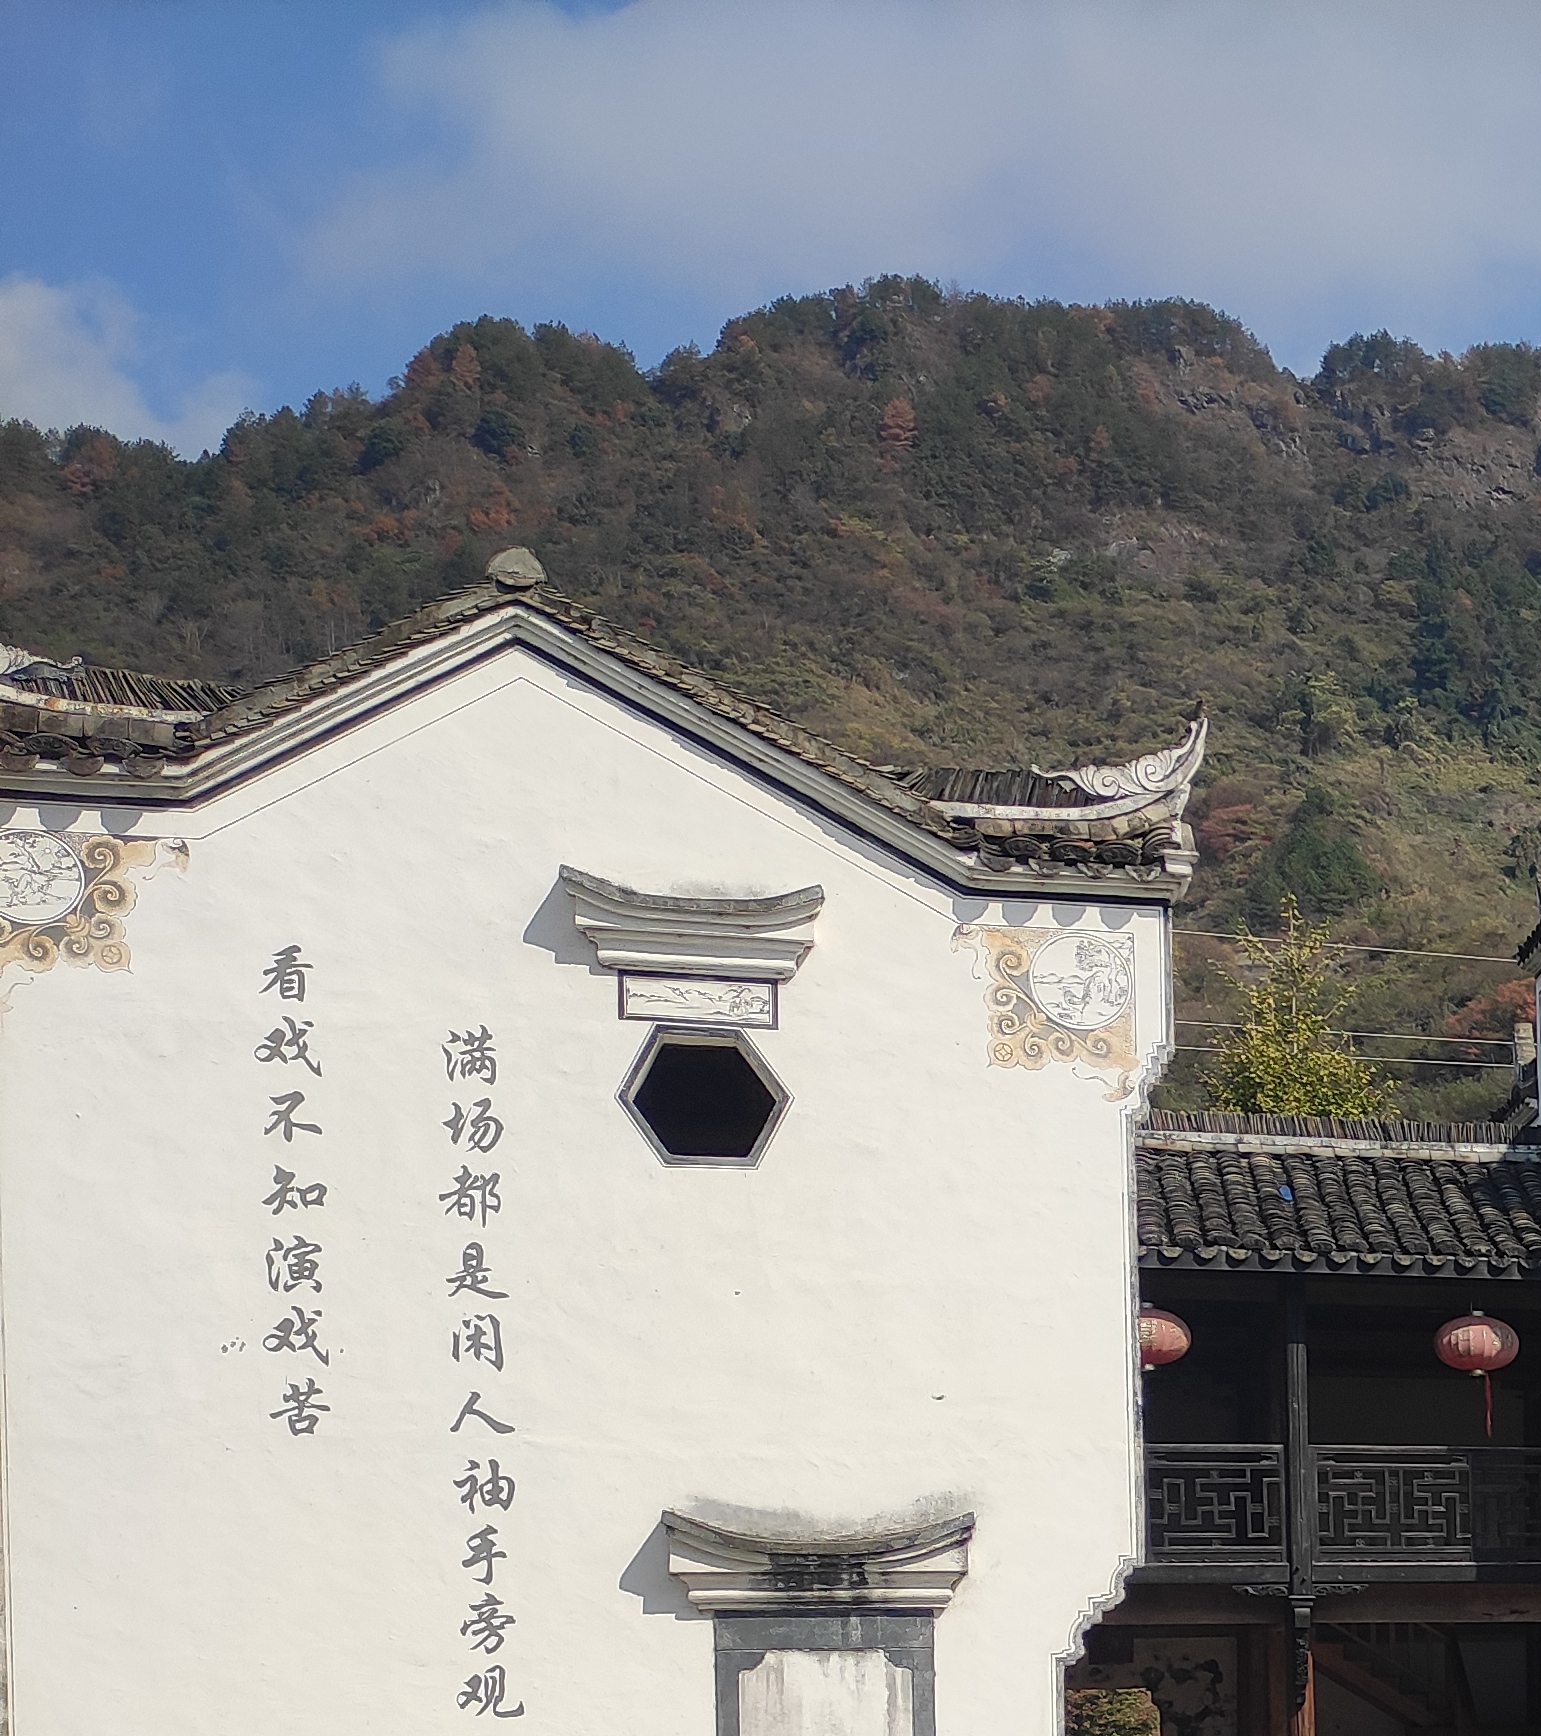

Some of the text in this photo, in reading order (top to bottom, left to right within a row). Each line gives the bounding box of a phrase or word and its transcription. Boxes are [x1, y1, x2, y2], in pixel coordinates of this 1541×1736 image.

[252, 944, 332, 1438] 看戏不知演戏苦
[437, 1024, 525, 1719] 满场都是闲人袖手旁观
